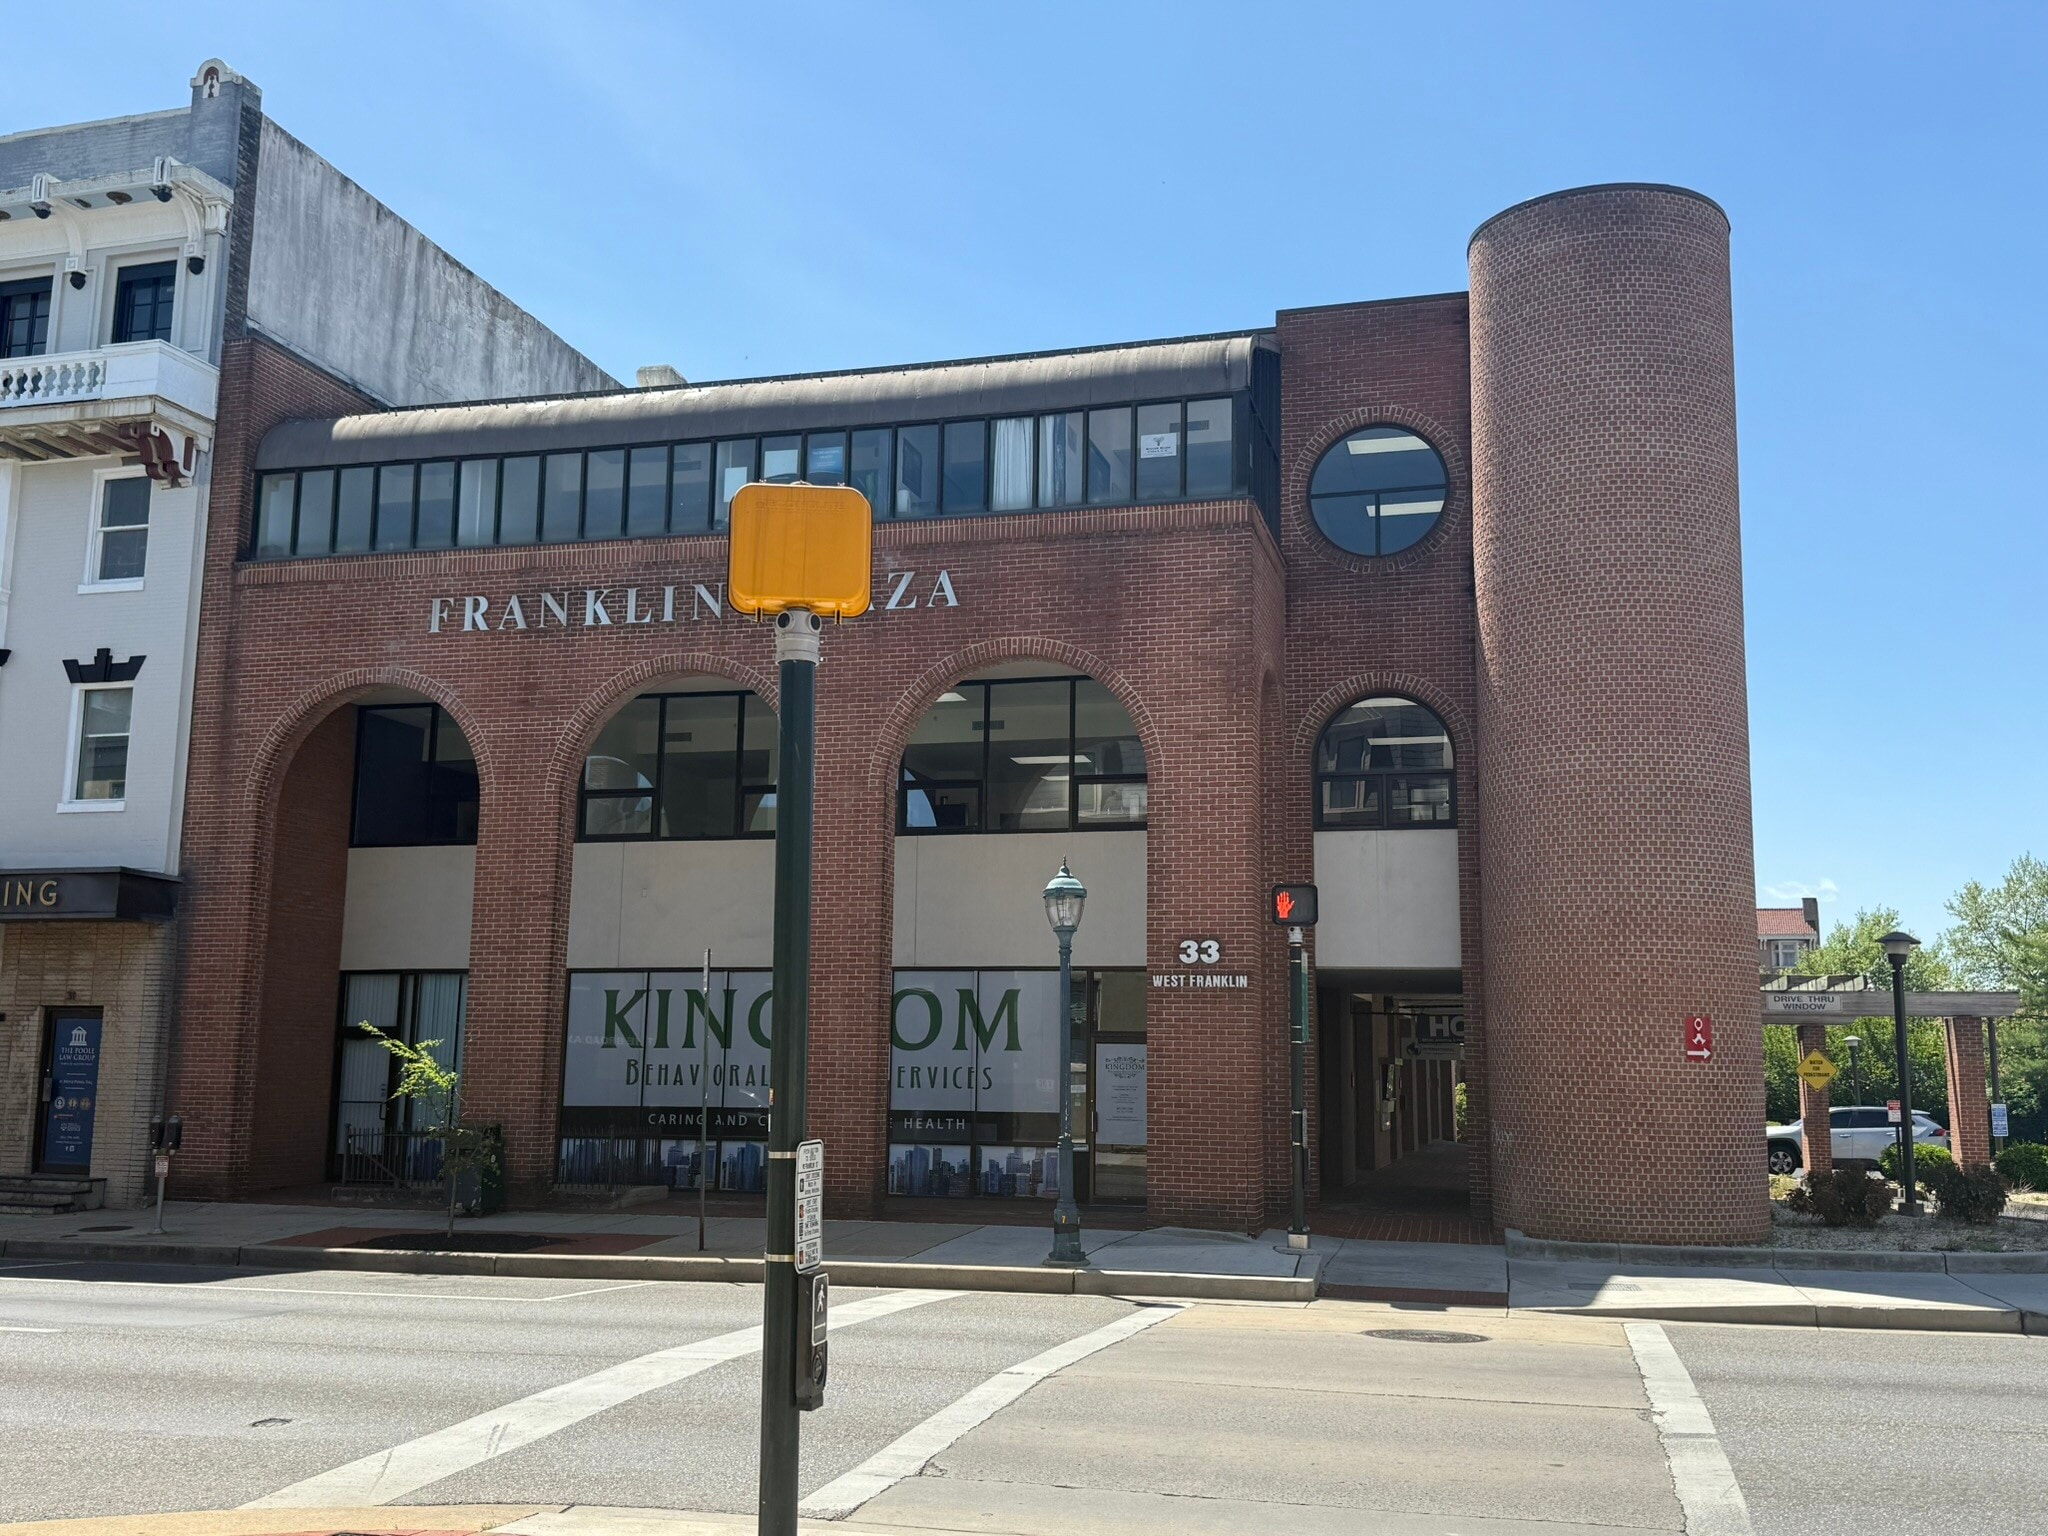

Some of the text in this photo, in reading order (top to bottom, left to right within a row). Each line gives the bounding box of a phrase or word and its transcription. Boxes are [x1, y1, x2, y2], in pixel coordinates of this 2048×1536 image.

[428, 583, 725, 633] FRANKLIN
[1179, 940, 1220, 964] 33
[1152, 975, 1248, 988] WEST FRANKLIN
[1808, 995, 1835, 1003] THRU
[1105, 1063, 1145, 1071] KINGDOM
[896, 1066, 993, 1090] ERVICES
[904, 1118, 965, 1130] HEALTH
